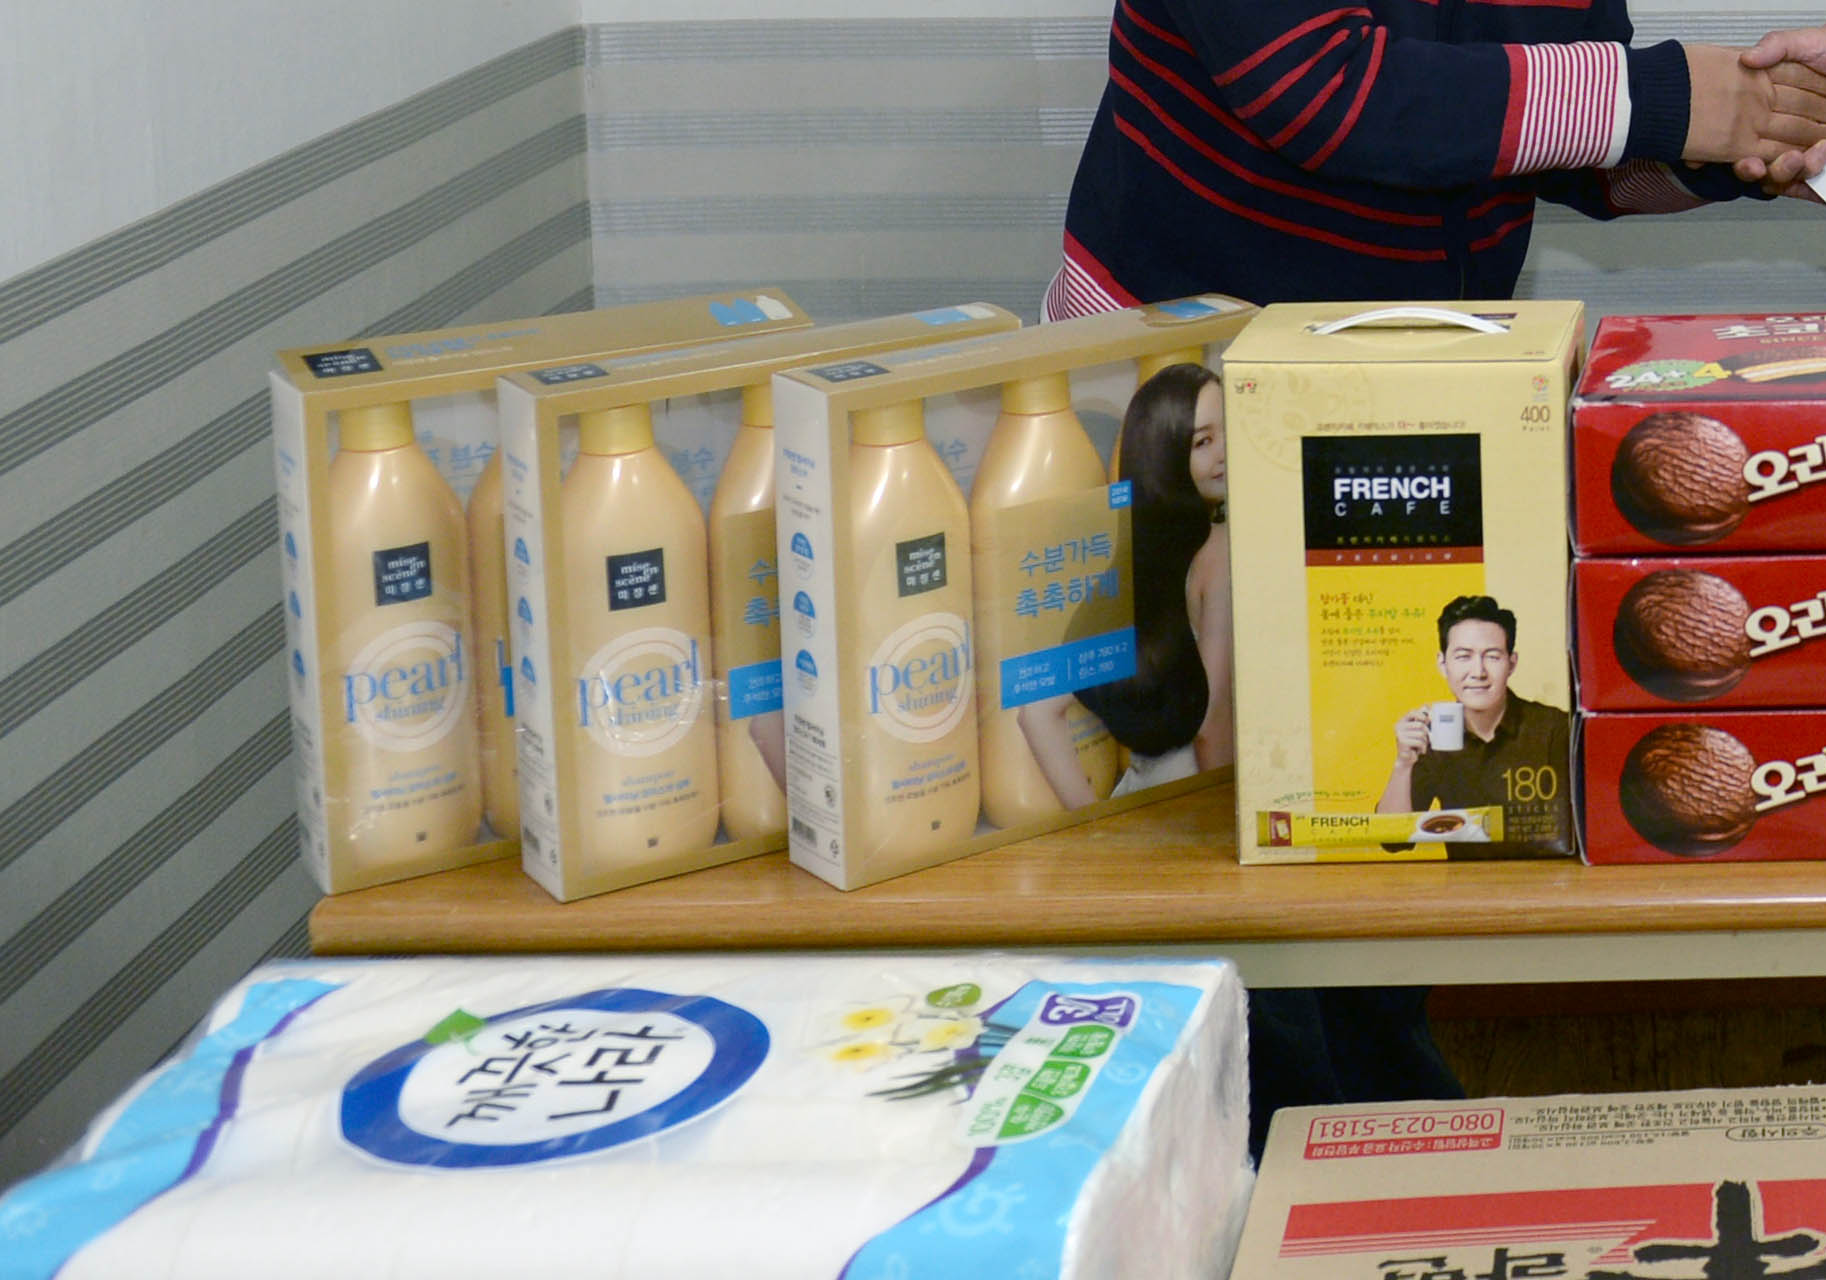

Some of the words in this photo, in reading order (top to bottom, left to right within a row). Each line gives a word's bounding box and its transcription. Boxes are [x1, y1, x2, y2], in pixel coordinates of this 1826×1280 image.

[1520, 405, 1550, 423] 400
[1334, 476, 1450, 500] FRENCH
[1020, 533, 1112, 576] 수분가득
[1016, 568, 1119, 617] 촉촉하게
[344, 631, 463, 723] pearl
[578, 639, 699, 727] pearl
[869, 622, 973, 715] pearl
[1502, 766, 1558, 801] 180
[1311, 816, 1370, 828] FRENCH
[447, 1024, 597, 1128] 깨끗한
[548, 1025, 684, 1120] 나라
[1318, 1112, 1496, 1139] 080-023-5181
